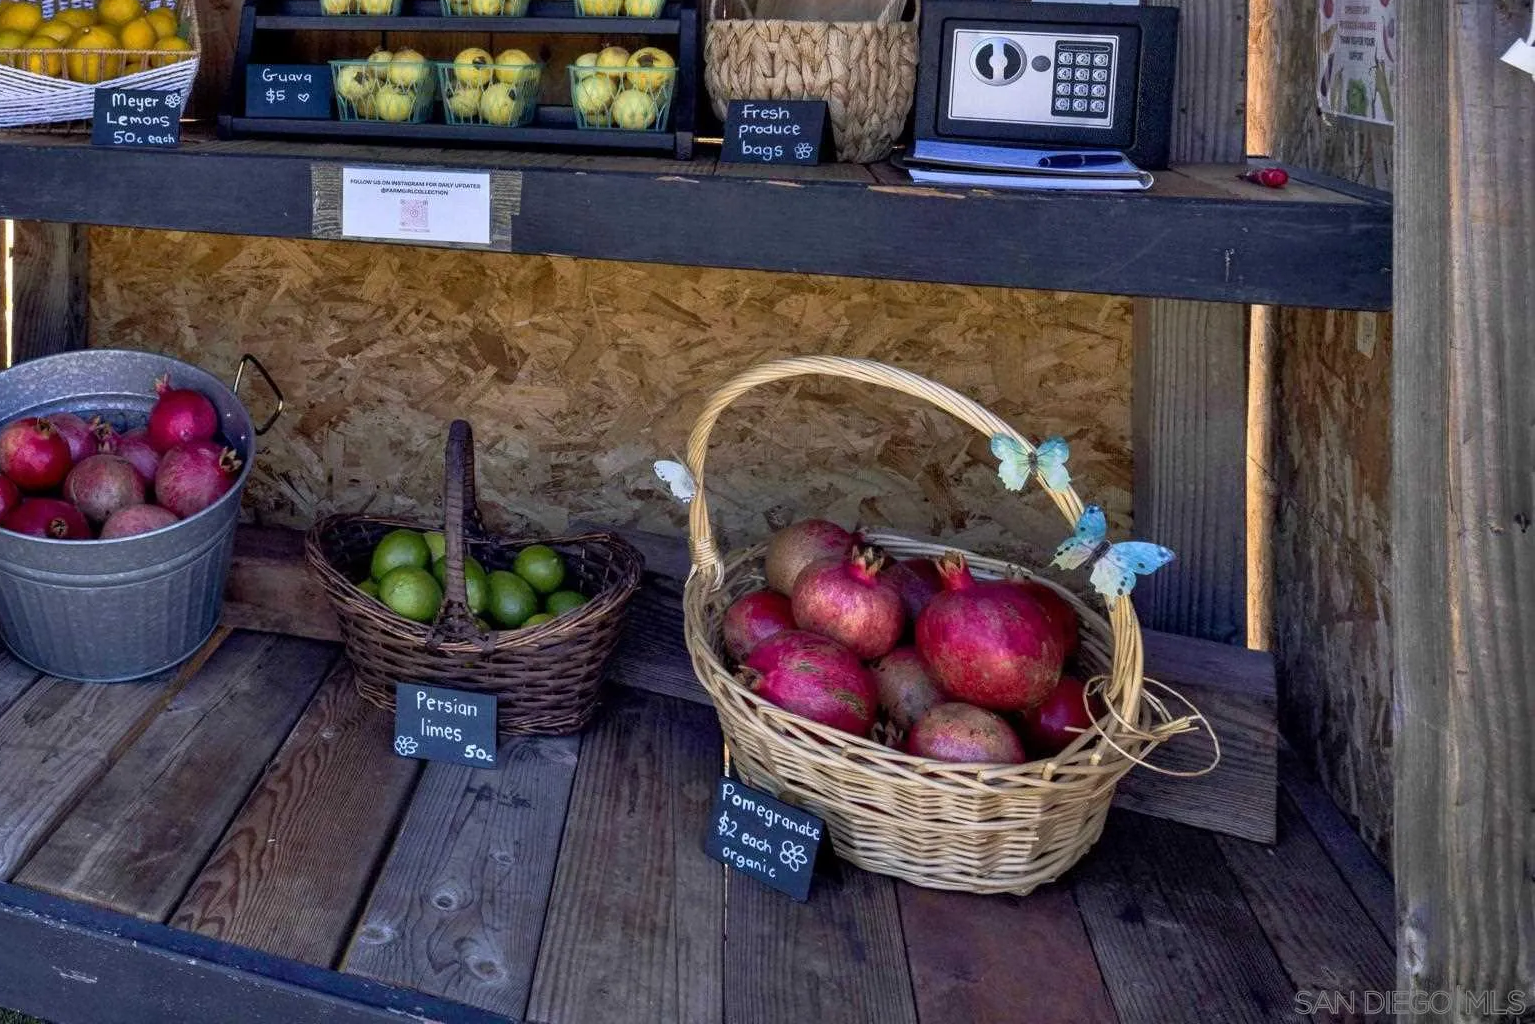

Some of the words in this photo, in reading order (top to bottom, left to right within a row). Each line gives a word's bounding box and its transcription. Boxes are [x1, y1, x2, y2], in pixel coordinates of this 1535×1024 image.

[262, 68, 312, 83] Guava
[112, 92, 159, 112] Meyer
[265, 88, 286, 104] $5
[106, 112, 170, 127] Lemons
[742, 104, 790, 119] Fresh
[148, 134, 175, 144] each
[738, 124, 801, 138] produce
[742, 141, 784, 161] bags
[416, 691, 478, 716] Persian
[421, 717, 462, 742] limes
[722, 783, 820, 841] Pomegranate
[717, 810, 738, 838] $2
[741, 833, 772, 855] each
[722, 847, 776, 878] organic
